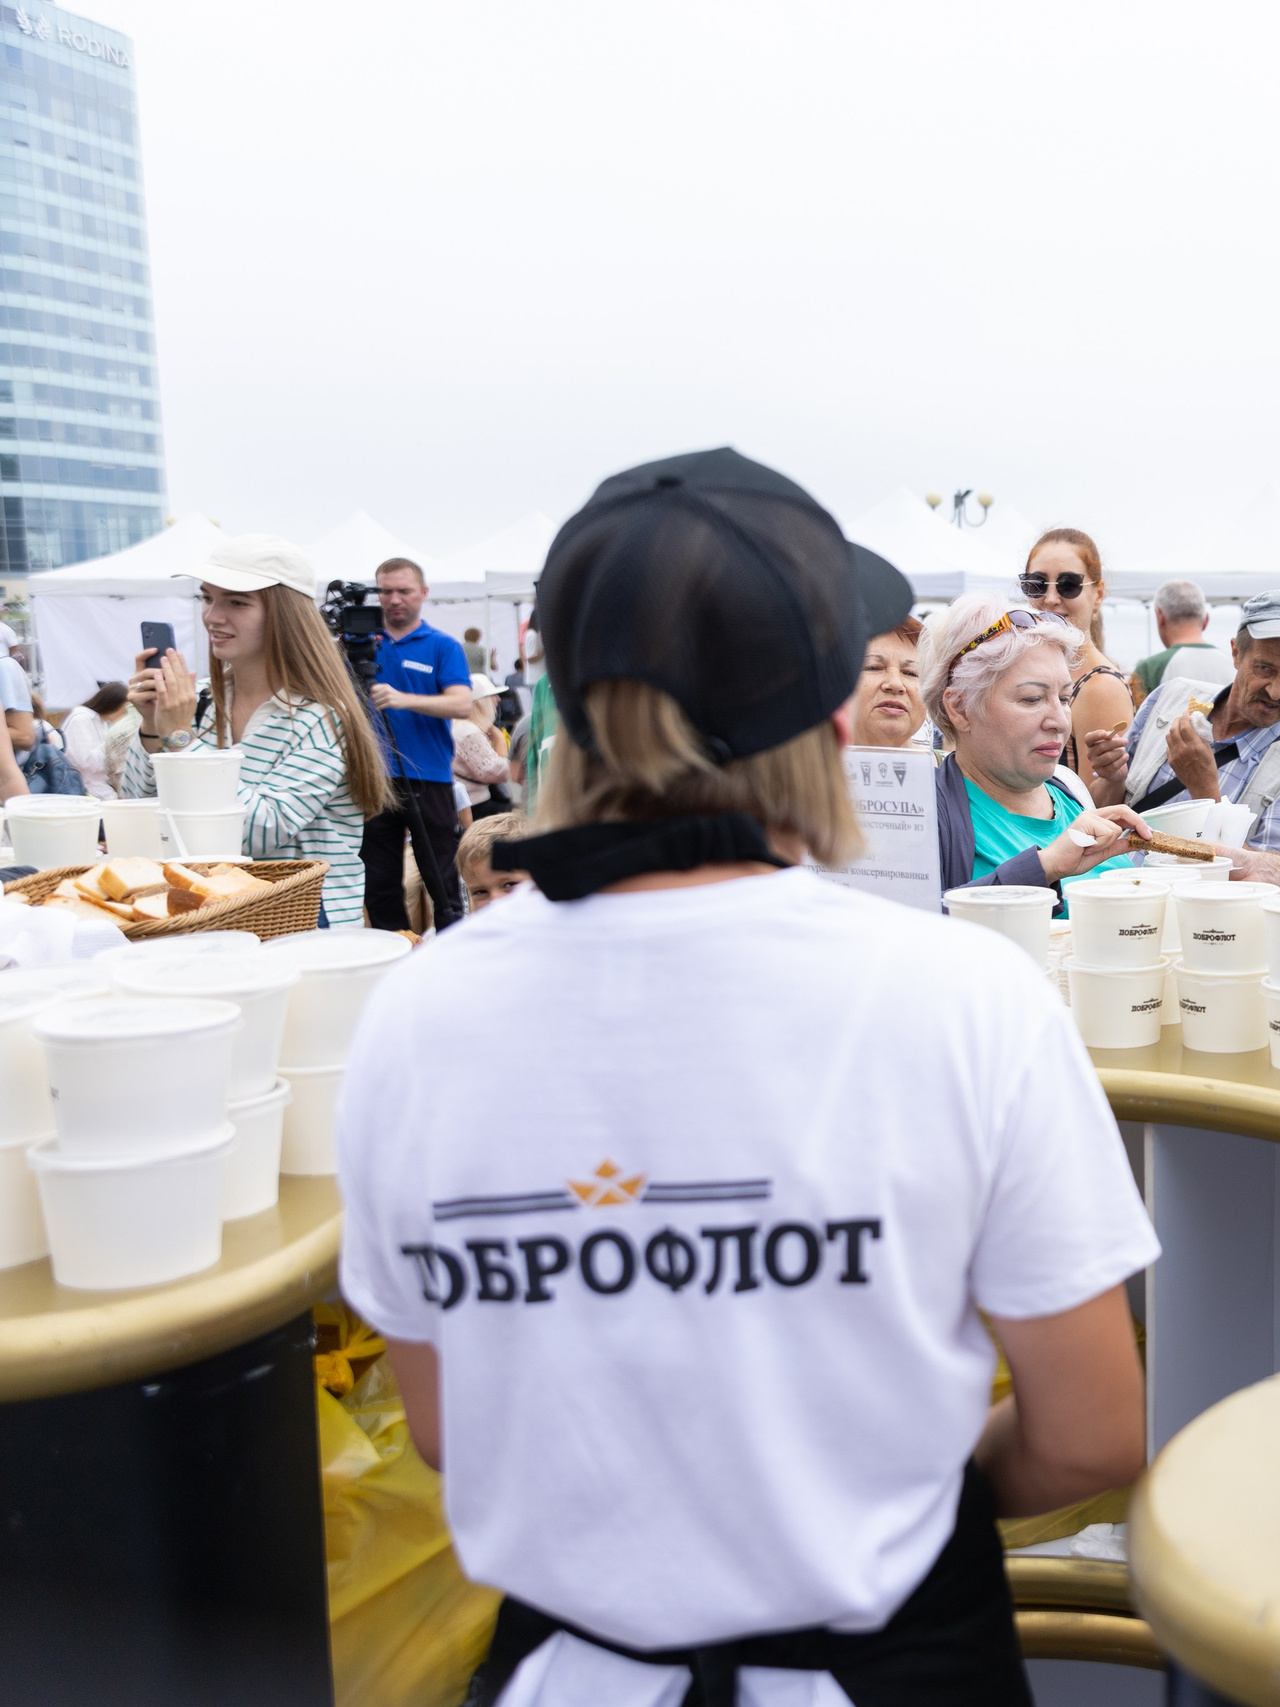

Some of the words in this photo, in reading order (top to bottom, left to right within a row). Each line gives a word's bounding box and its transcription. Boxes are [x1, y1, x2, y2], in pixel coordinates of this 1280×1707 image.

[58, 26, 130, 68] RODINA
[853, 800, 925, 814] БРОСУПА»
[1118, 927, 1158, 936] ДОБРОФЛОТ
[1193, 932, 1236, 942] ДОБРОФЛОТ
